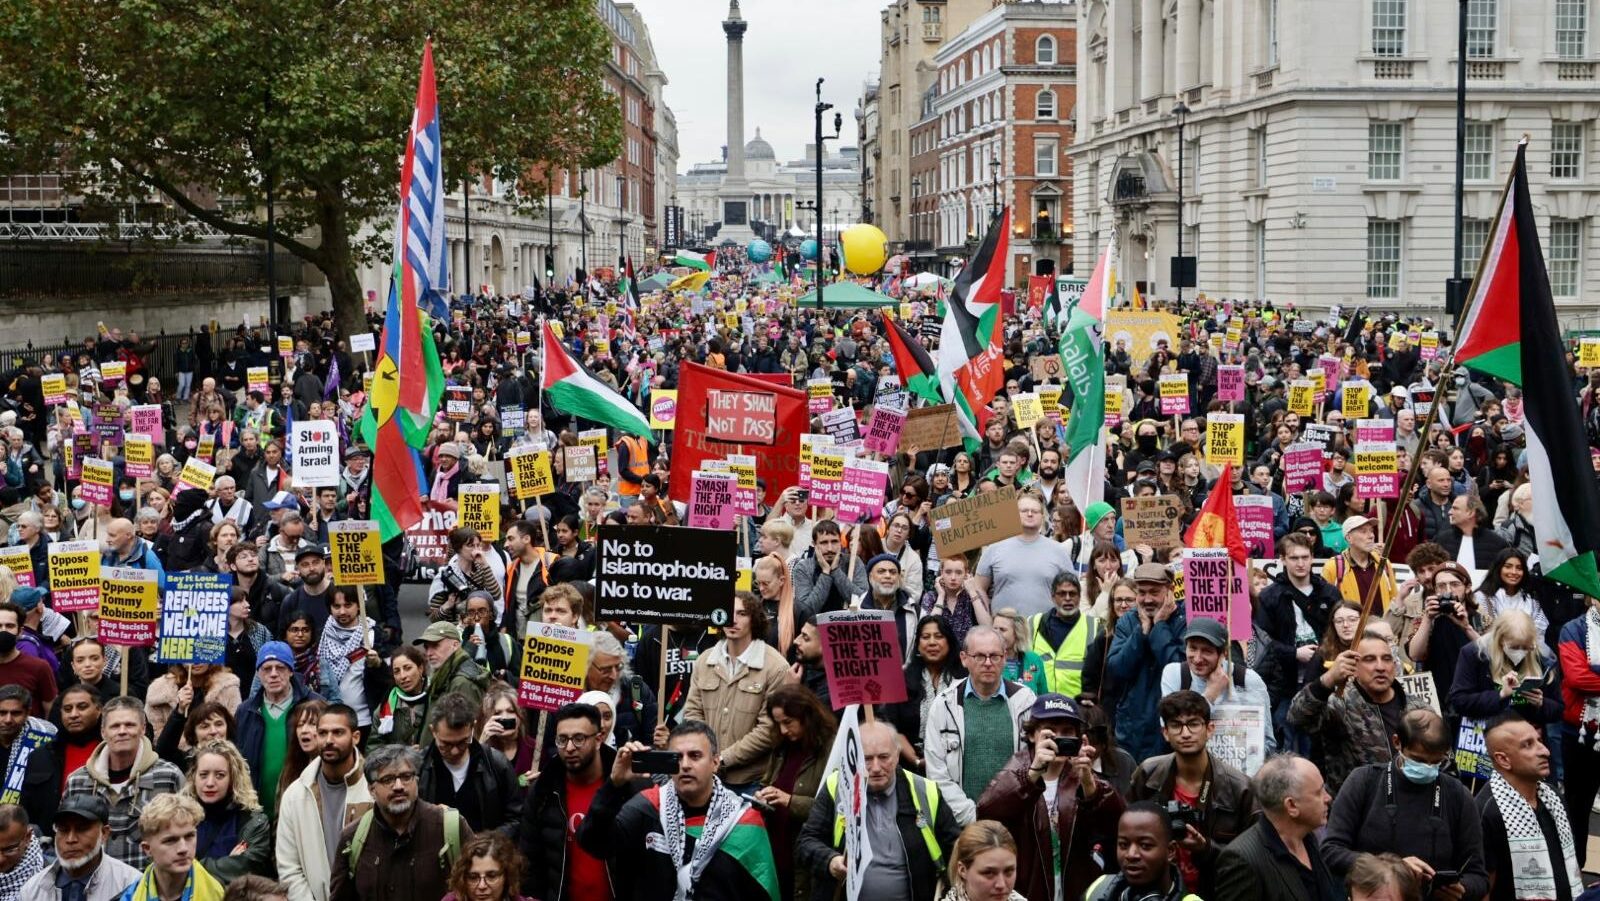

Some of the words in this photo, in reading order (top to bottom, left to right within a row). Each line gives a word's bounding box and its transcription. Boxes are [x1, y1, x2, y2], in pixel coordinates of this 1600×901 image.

[1060, 284, 1087, 294] BRIS
[1161, 382, 1187, 390] Refugees
[710, 391, 738, 411] THEY
[744, 394, 775, 414] SHALL
[135, 410, 155, 418] SMASH
[876, 410, 901, 425] SMASH
[136, 425, 154, 433] RIGHT
[709, 416, 736, 435] NOT
[743, 417, 774, 440] PASS
[873, 419, 888, 431] THE
[887, 424, 902, 435] FAR
[1212, 423, 1235, 432] STOP
[870, 427, 893, 441] RIGHT
[1212, 431, 1228, 440] THE
[1307, 429, 1331, 441] Black
[299, 445, 333, 454] Arming
[1212, 439, 1228, 448] FAR
[1212, 448, 1239, 456] RIGHT
[301, 455, 331, 466] Israel
[516, 453, 540, 465] STOP
[813, 456, 844, 469] Refuge
[1358, 453, 1396, 464] Refugees
[83, 465, 112, 478] Refugees
[518, 462, 536, 473] THE
[1287, 460, 1321, 472] Refugees
[1358, 462, 1395, 472] welcome
[83, 473, 110, 484] welcome
[519, 471, 537, 481] FAR
[1288, 469, 1321, 479] welcome
[1358, 475, 1377, 486] Stop
[1379, 474, 1394, 484] the
[521, 476, 549, 490] RIGHT
[696, 480, 729, 492] SMASH
[812, 481, 832, 492] Stop
[1287, 478, 1306, 487] here
[843, 482, 883, 497] Refugees
[1358, 484, 1371, 493] far
[1372, 484, 1394, 495] right
[464, 494, 489, 503] STOP
[696, 492, 712, 503] THE
[714, 492, 732, 505] FAR
[811, 492, 824, 501] far
[841, 491, 880, 506] welcome
[464, 503, 482, 513] THE
[694, 504, 723, 516] RIGHT
[840, 502, 861, 513] here
[929, 490, 1017, 520] MULTICULTURALISM
[464, 512, 482, 521] FAR
[464, 521, 493, 531] RIGHT
[336, 532, 368, 543] STOP
[940, 519, 998, 546] BEAUTIFUL
[338, 542, 361, 553] THE
[408, 534, 442, 549] THE
[602, 540, 631, 556] No
[634, 541, 654, 557] to
[52, 555, 89, 567] Oppose
[339, 553, 361, 563] FAR
[1192, 551, 1215, 560] Socialist
[53, 565, 88, 577] Tommy
[340, 562, 376, 574] RIGHT
[602, 558, 729, 581] Islamophobia.
[1190, 560, 1235, 578] SMASH
[53, 576, 100, 589] Robinson
[167, 575, 184, 584] Say
[102, 580, 145, 595] Oppose
[177, 582, 194, 591] Say
[205, 582, 229, 590] Clear
[601, 581, 629, 598] No
[632, 582, 653, 599] to
[655, 587, 692, 602] war.
[1191, 578, 1215, 595] THE
[1220, 578, 1243, 594] FAR
[54, 591, 70, 601] Stop
[72, 590, 97, 599] fascists
[102, 592, 142, 608] Tommy
[164, 590, 229, 612] REFUGEES
[63, 599, 75, 607] the
[77, 598, 87, 606] far
[1191, 595, 1229, 612] RIGHT
[101, 605, 154, 619] Robinson
[601, 609, 614, 618] Stop
[615, 609, 624, 617] the
[625, 609, 635, 618] War
[828, 613, 857, 624] Socialist
[858, 612, 882, 622] Worker
[100, 620, 117, 630] Stop
[119, 621, 149, 631] fascists
[163, 612, 228, 638] WELCOME
[100, 629, 107, 637] &
[110, 629, 122, 638] the
[123, 630, 134, 639] far
[136, 631, 153, 641] right
[827, 624, 883, 643] SMASH
[160, 637, 195, 660] HERE
[528, 637, 575, 656] Oppose
[828, 641, 860, 660] THE
[863, 639, 893, 658] FAR
[526, 652, 572, 673] Tommy
[832, 658, 880, 679] RIGHT
[524, 665, 582, 686] Robinson
[522, 681, 541, 694] Stop
[543, 684, 575, 698] fascists
[1404, 676, 1430, 695] THE
[521, 691, 527, 699] &
[529, 692, 543, 702] the
[545, 694, 557, 704] far
[1455, 749, 1477, 774] HERE
